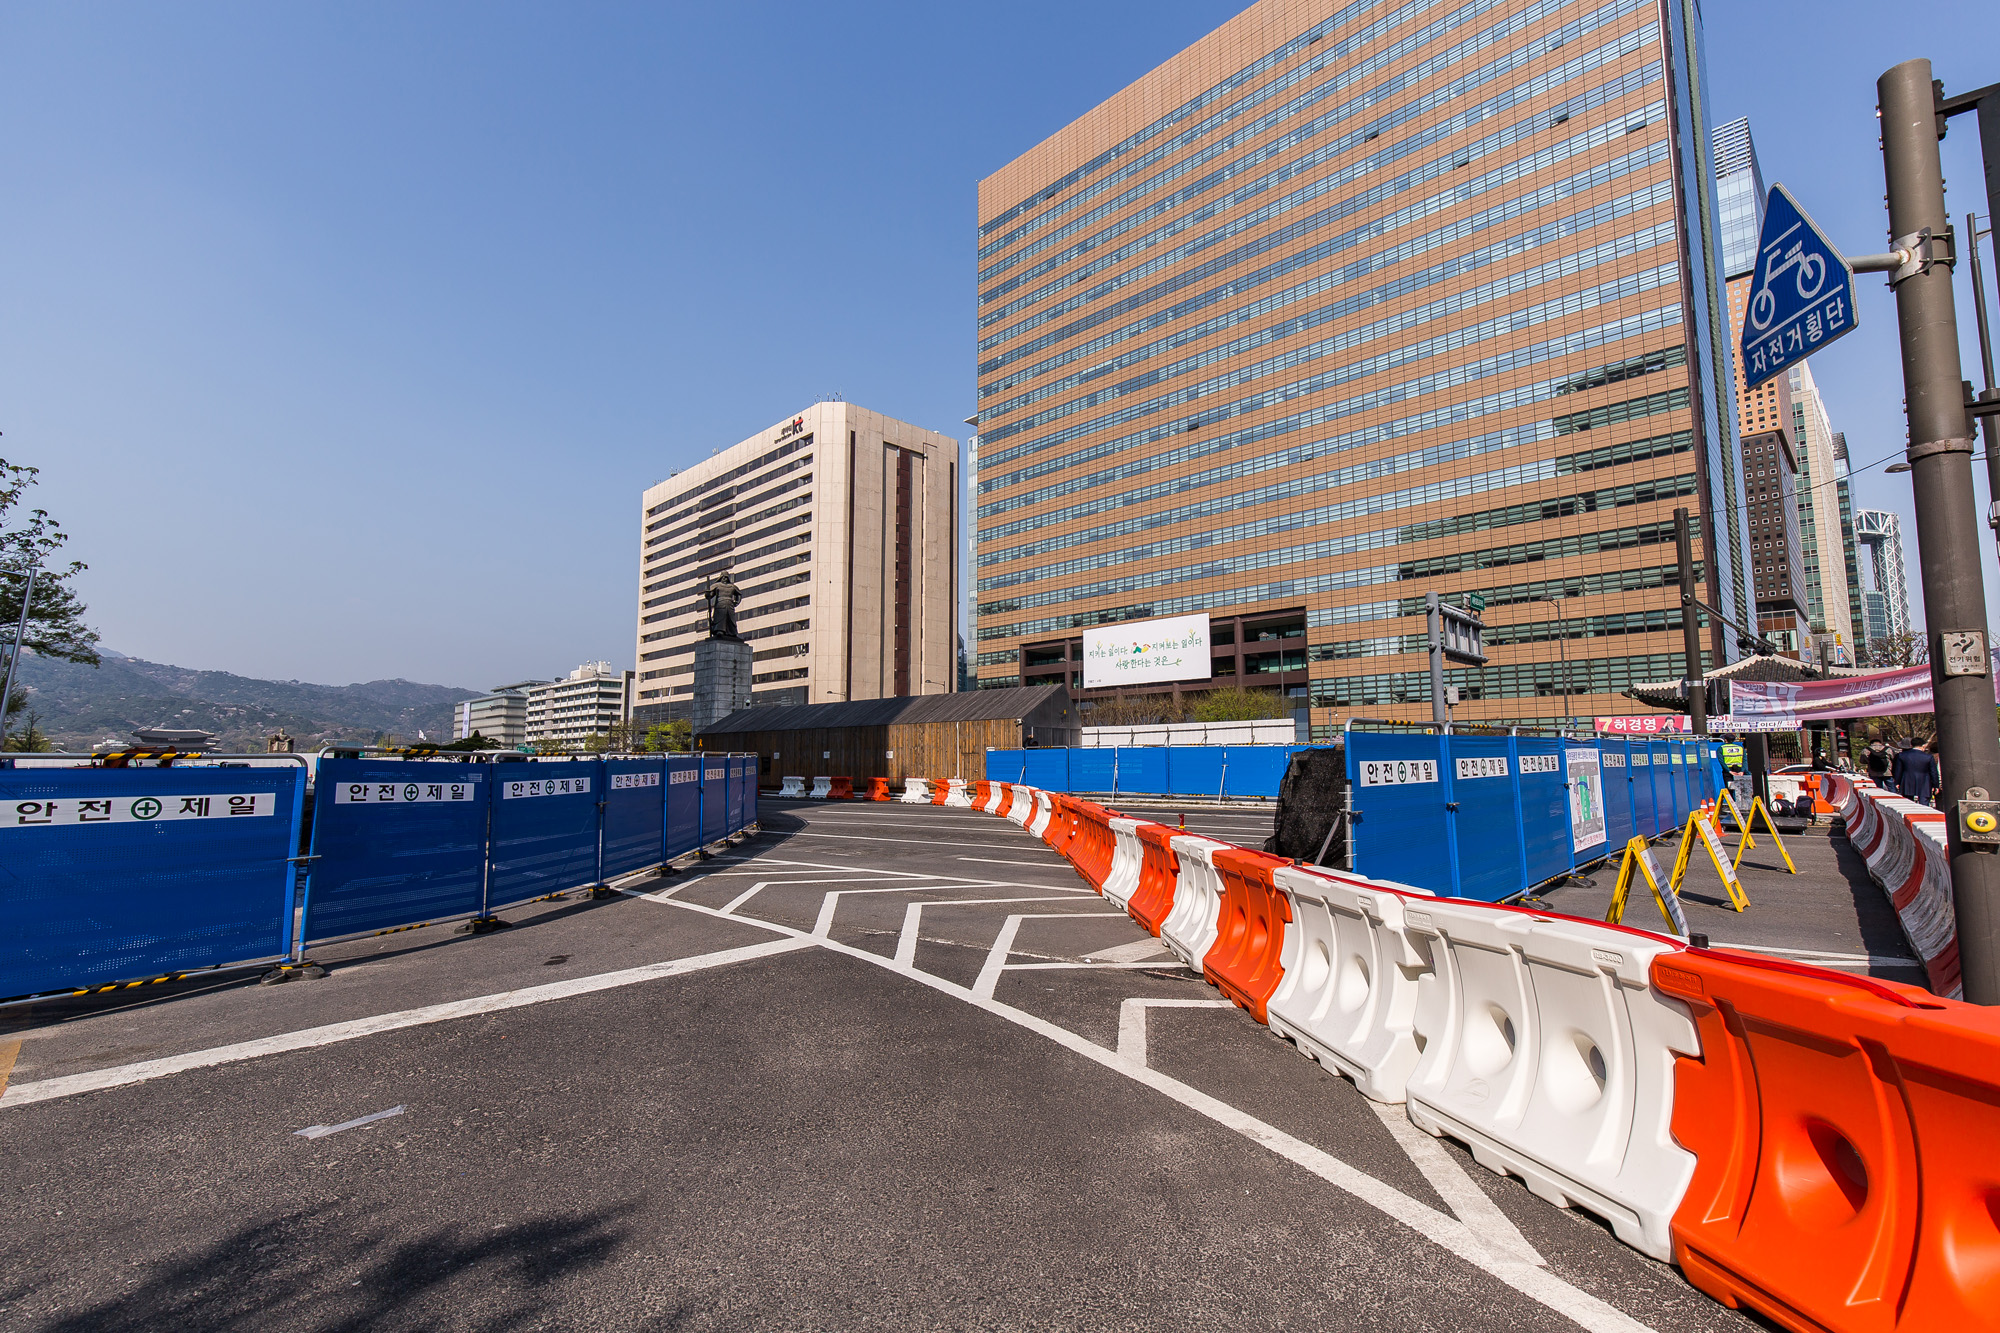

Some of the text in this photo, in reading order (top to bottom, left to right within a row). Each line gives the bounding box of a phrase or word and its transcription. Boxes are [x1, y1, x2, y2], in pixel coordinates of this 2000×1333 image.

[1751, 296, 1845, 374] 자전거횡단
[792, 416, 804, 436] kt
[1115, 657, 1151, 671] 사랑한다는
[1949, 655, 1981, 663] 전기위험
[1598, 717, 1657, 733] 7 허경영
